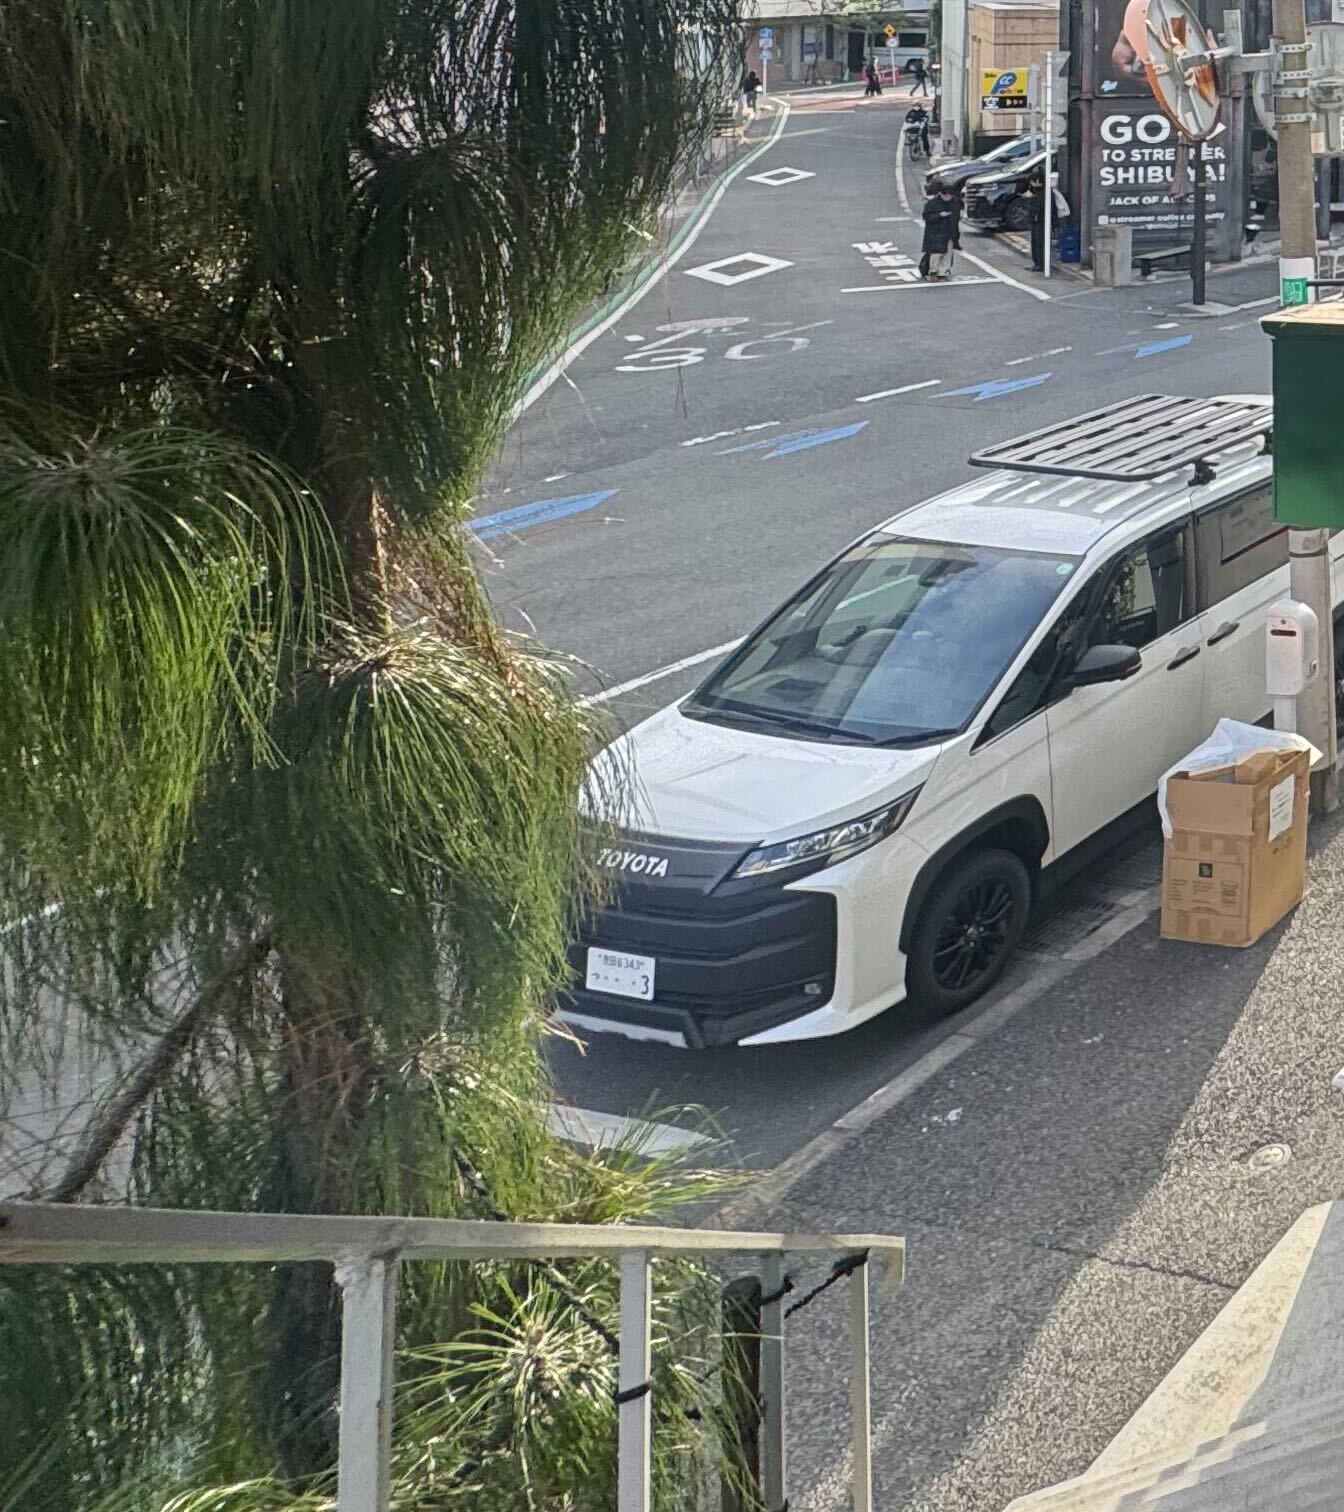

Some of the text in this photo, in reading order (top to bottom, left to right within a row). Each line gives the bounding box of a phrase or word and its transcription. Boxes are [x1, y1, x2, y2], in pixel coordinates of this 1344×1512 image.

[1100, 114, 1171, 145] GO
[1102, 149, 1126, 162] TO
[1110, 196, 1139, 206] JACK
[1142, 195, 1160, 204] OF
[597, 848, 669, 878] TOYOTA
